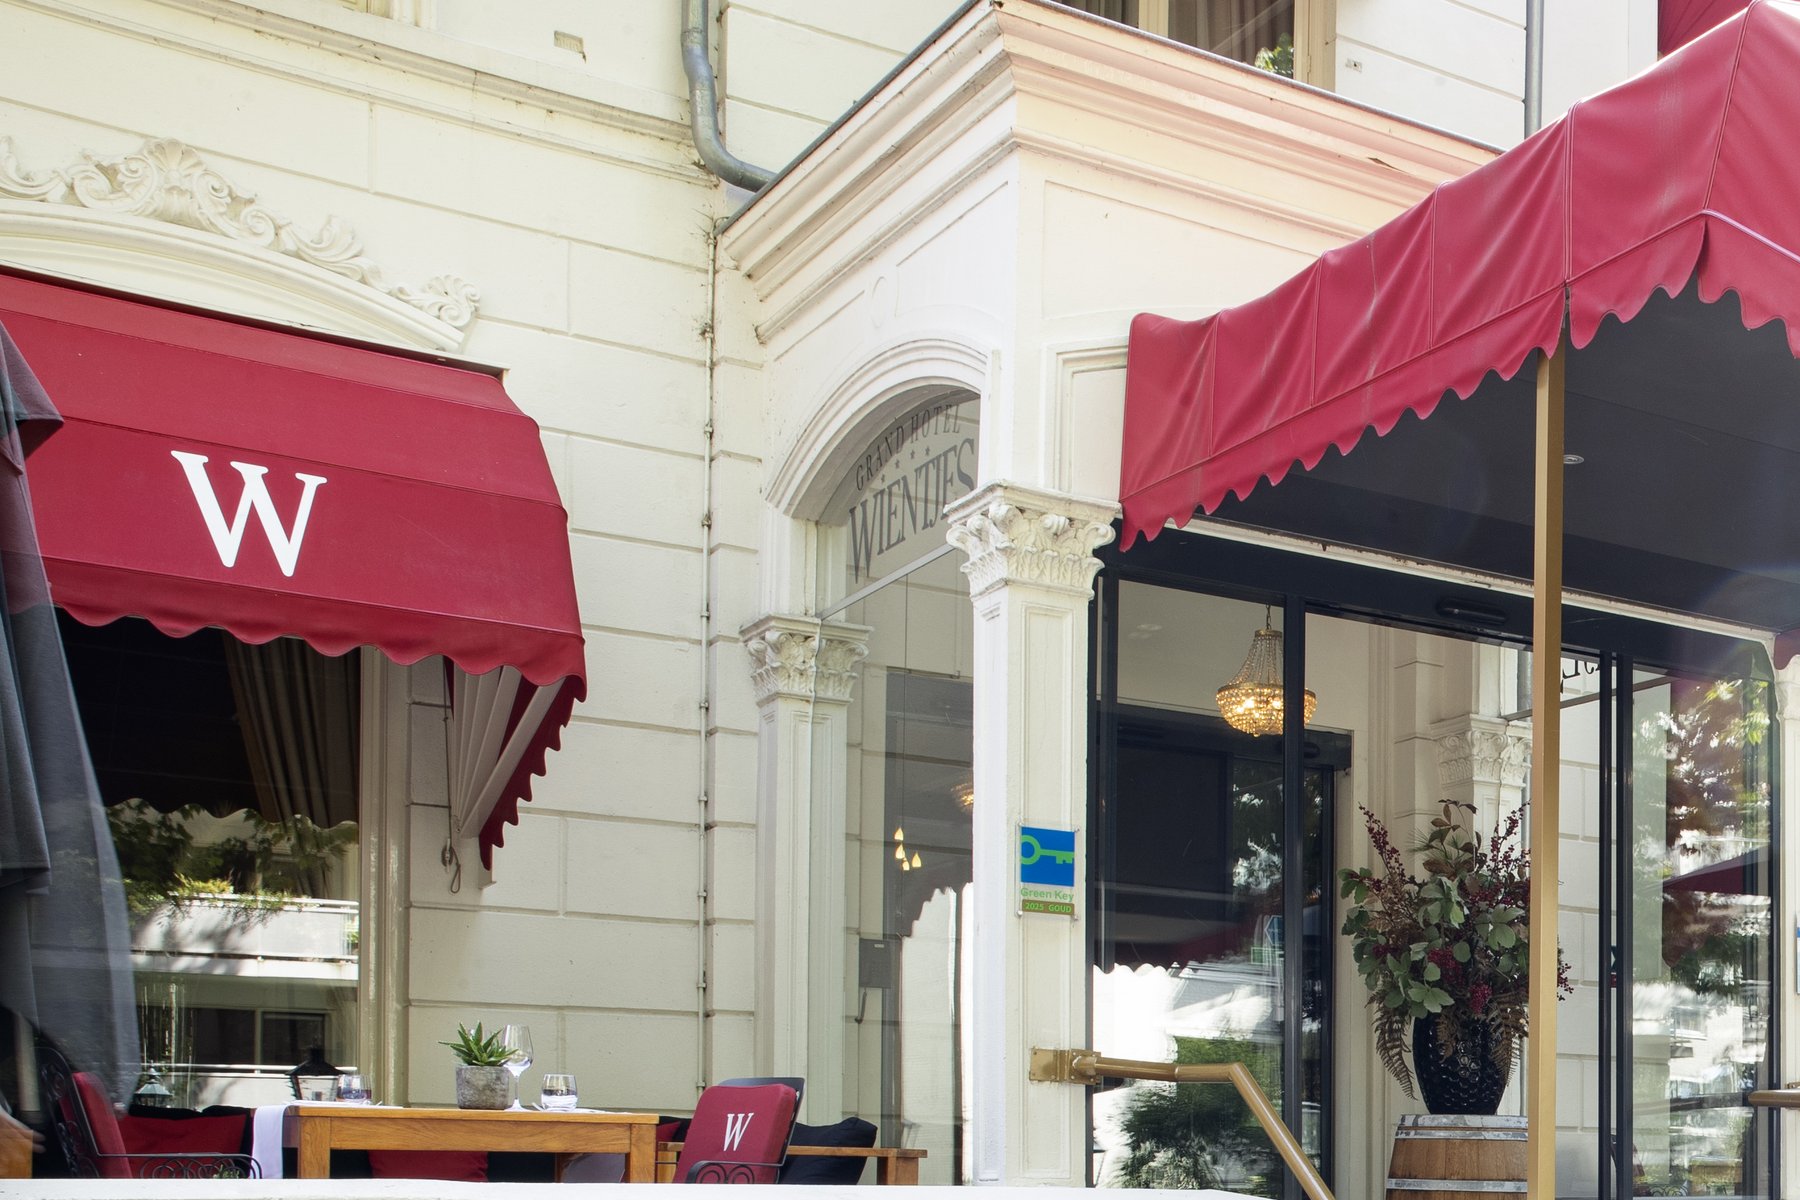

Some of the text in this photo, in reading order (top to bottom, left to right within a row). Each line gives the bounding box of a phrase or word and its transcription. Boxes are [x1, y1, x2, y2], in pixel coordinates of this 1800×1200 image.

[856, 403, 961, 492] GRAND HOTEL
[170, 450, 328, 577] W
[849, 437, 975, 585] WIENTJES
[1020, 886, 1075, 903] Green Key
[1025, 902, 1073, 913] 2025 GOUD
[723, 1111, 755, 1152] W
